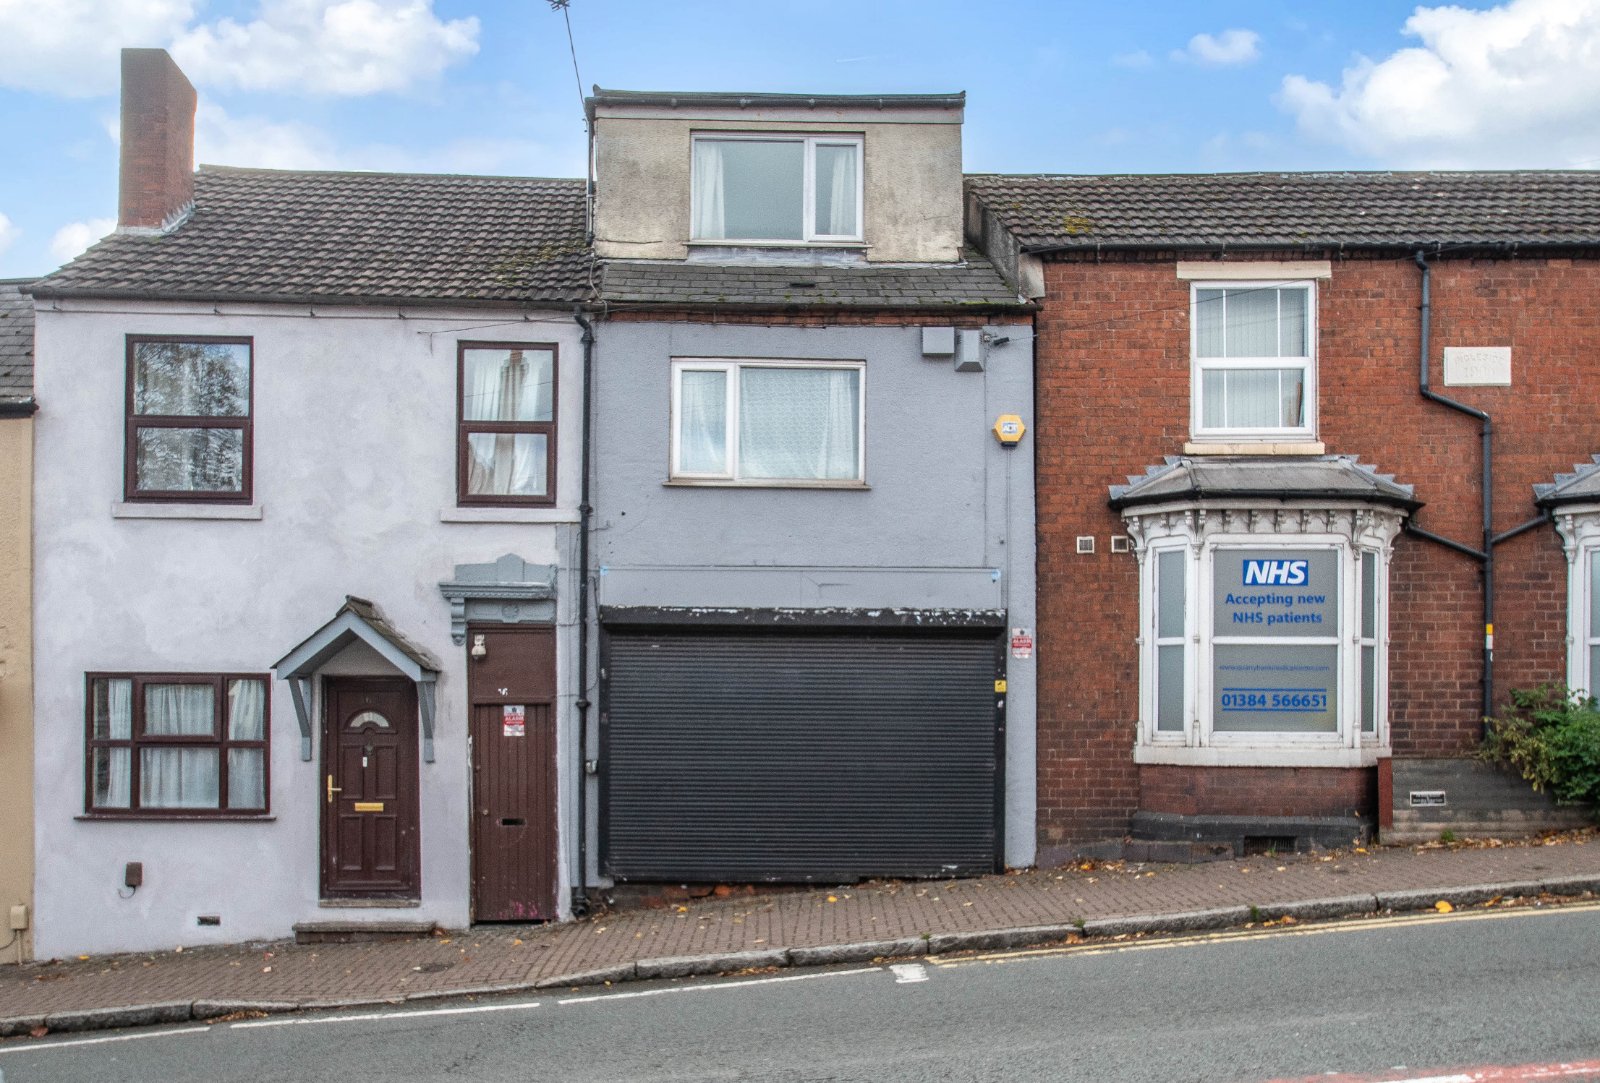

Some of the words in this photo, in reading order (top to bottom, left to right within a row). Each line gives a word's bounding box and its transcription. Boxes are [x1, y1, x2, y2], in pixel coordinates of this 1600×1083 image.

[1244, 560, 1307, 585] NHS
[1225, 593, 1293, 607] Accepting
[1297, 594, 1326, 605] new
[1233, 612, 1263, 624] NHS
[1267, 612, 1322, 626] patients
[1221, 693, 1267, 707] 01384
[1271, 694, 1328, 708] 566651
